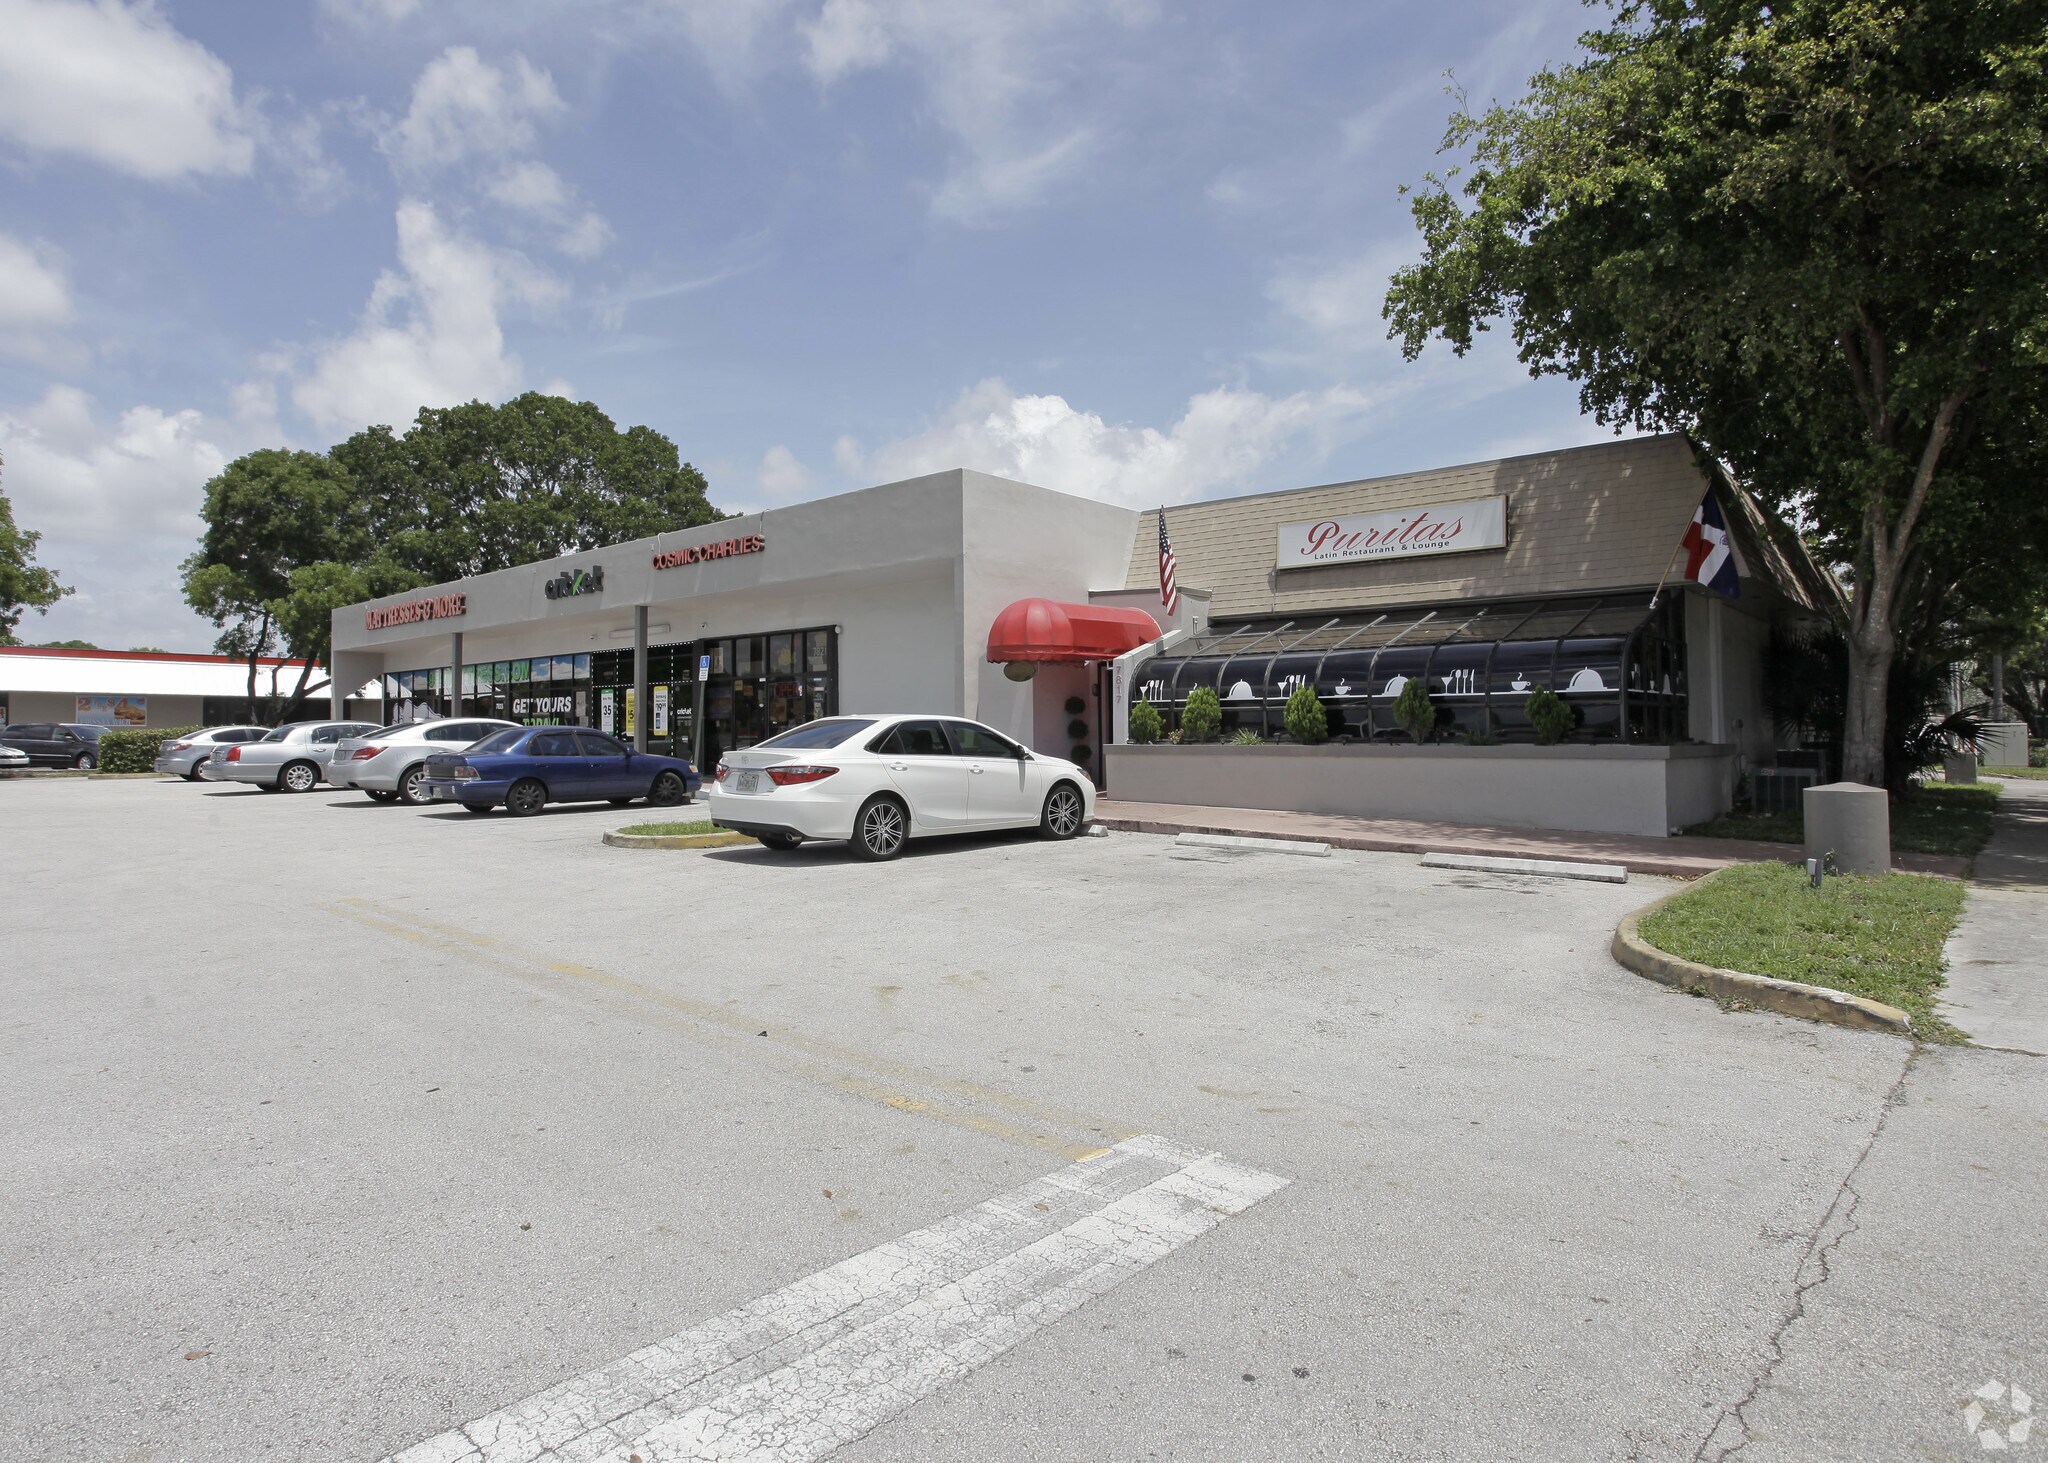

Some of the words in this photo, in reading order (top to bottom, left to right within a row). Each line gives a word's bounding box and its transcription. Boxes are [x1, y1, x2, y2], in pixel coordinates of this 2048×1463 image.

[1301, 512, 1464, 555] Puritas
[651, 547, 698, 570] COSMIC
[698, 534, 765, 561] CHARLIES
[1314, 552, 1338, 560] Latin
[1342, 545, 1395, 557] Restaurant
[1401, 543, 1408, 551] &
[1412, 540, 1450, 550] Lounge
[545, 565, 604, 600] cricket
[365, 600, 422, 630] MATTRESSES
[423, 598, 433, 621] &
[432, 592, 466, 618] MORE
[812, 646, 827, 657] 7821
[78, 697, 91, 711] 2
[512, 698, 534, 714] GET
[535, 696, 572, 713] YOURS
